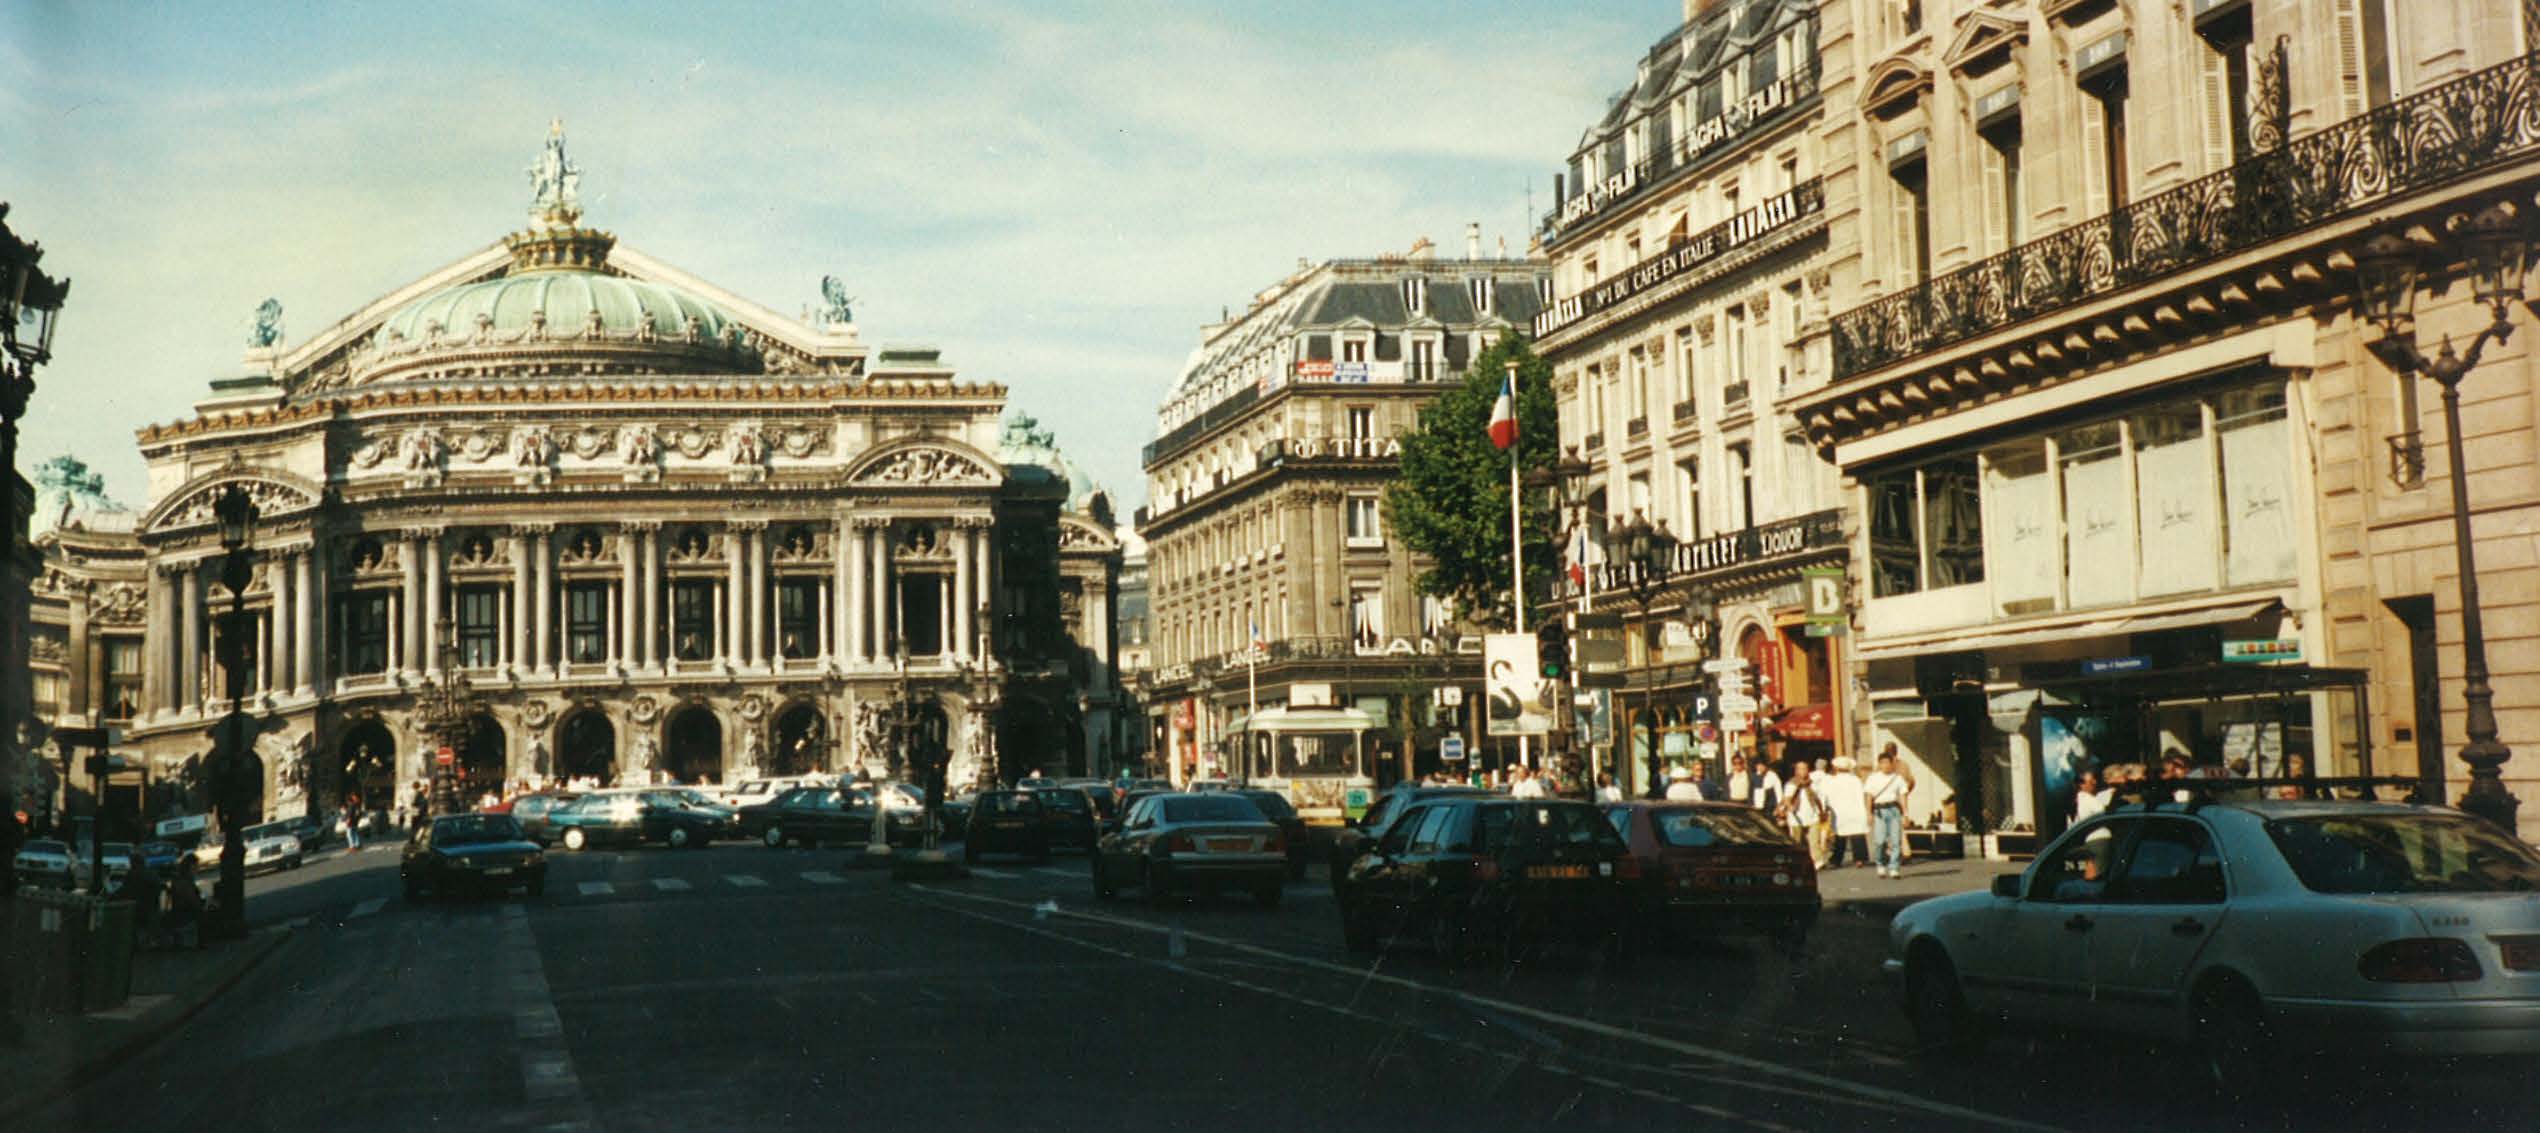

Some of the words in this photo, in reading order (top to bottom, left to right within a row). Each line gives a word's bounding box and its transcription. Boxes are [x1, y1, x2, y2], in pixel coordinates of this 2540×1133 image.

[1688, 114, 1726, 157] AGFA
[1748, 80, 1784, 121] FILM
[1608, 165, 1637, 200] FILM
[1535, 295, 1583, 338] LAVAZZA
[1662, 253, 1678, 276] EN
[1679, 235, 1715, 269] ITALIE
[1729, 193, 1798, 247] LAVAZZA
[1811, 578, 1840, 615] B
[1696, 697, 1709, 714] P
